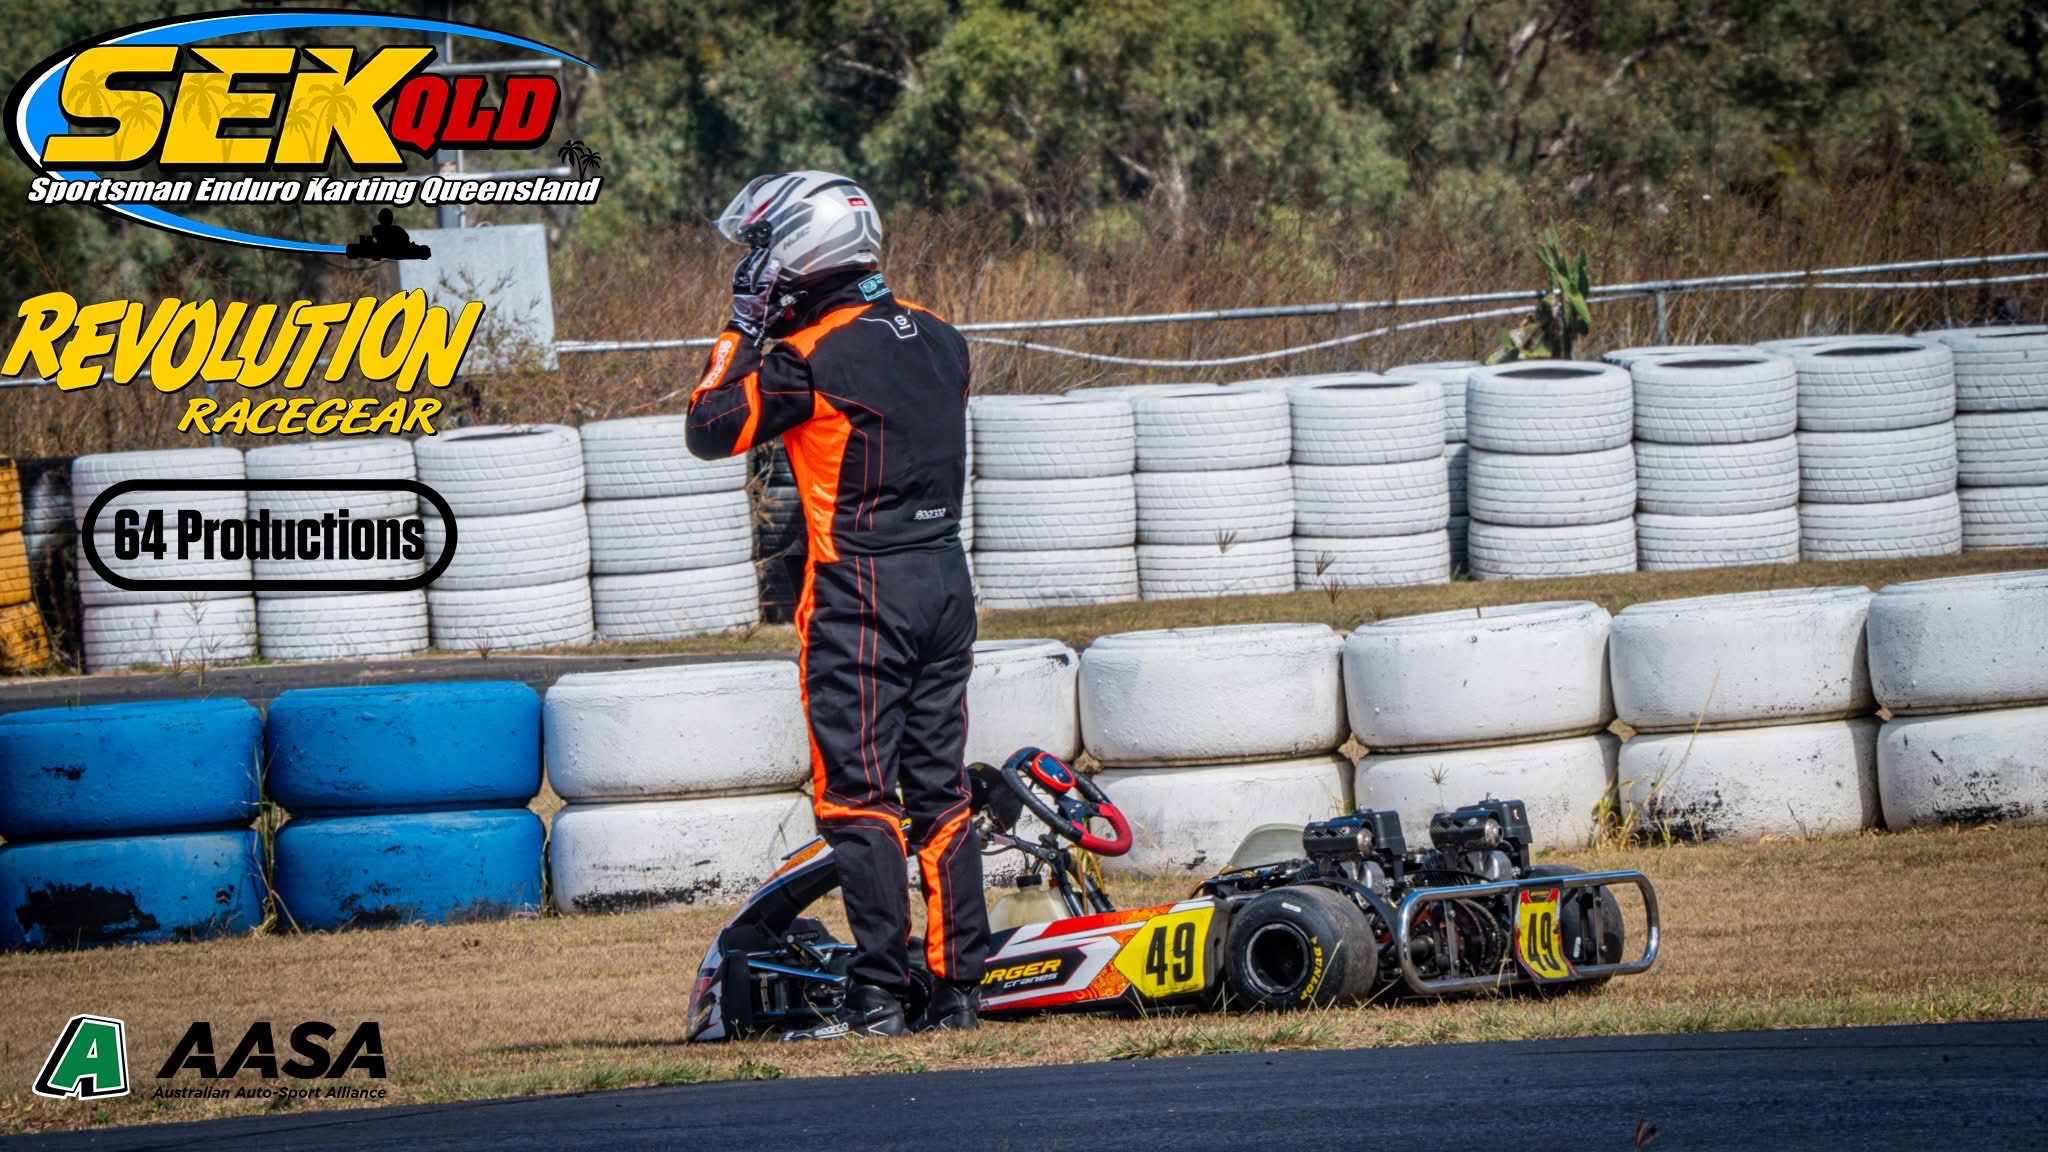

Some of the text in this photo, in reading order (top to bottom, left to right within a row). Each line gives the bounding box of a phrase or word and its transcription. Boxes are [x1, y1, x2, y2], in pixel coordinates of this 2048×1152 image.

[1146, 921, 1196, 986] 49
[1527, 912, 1561, 972] 49
[1003, 973, 1059, 989] cranes
